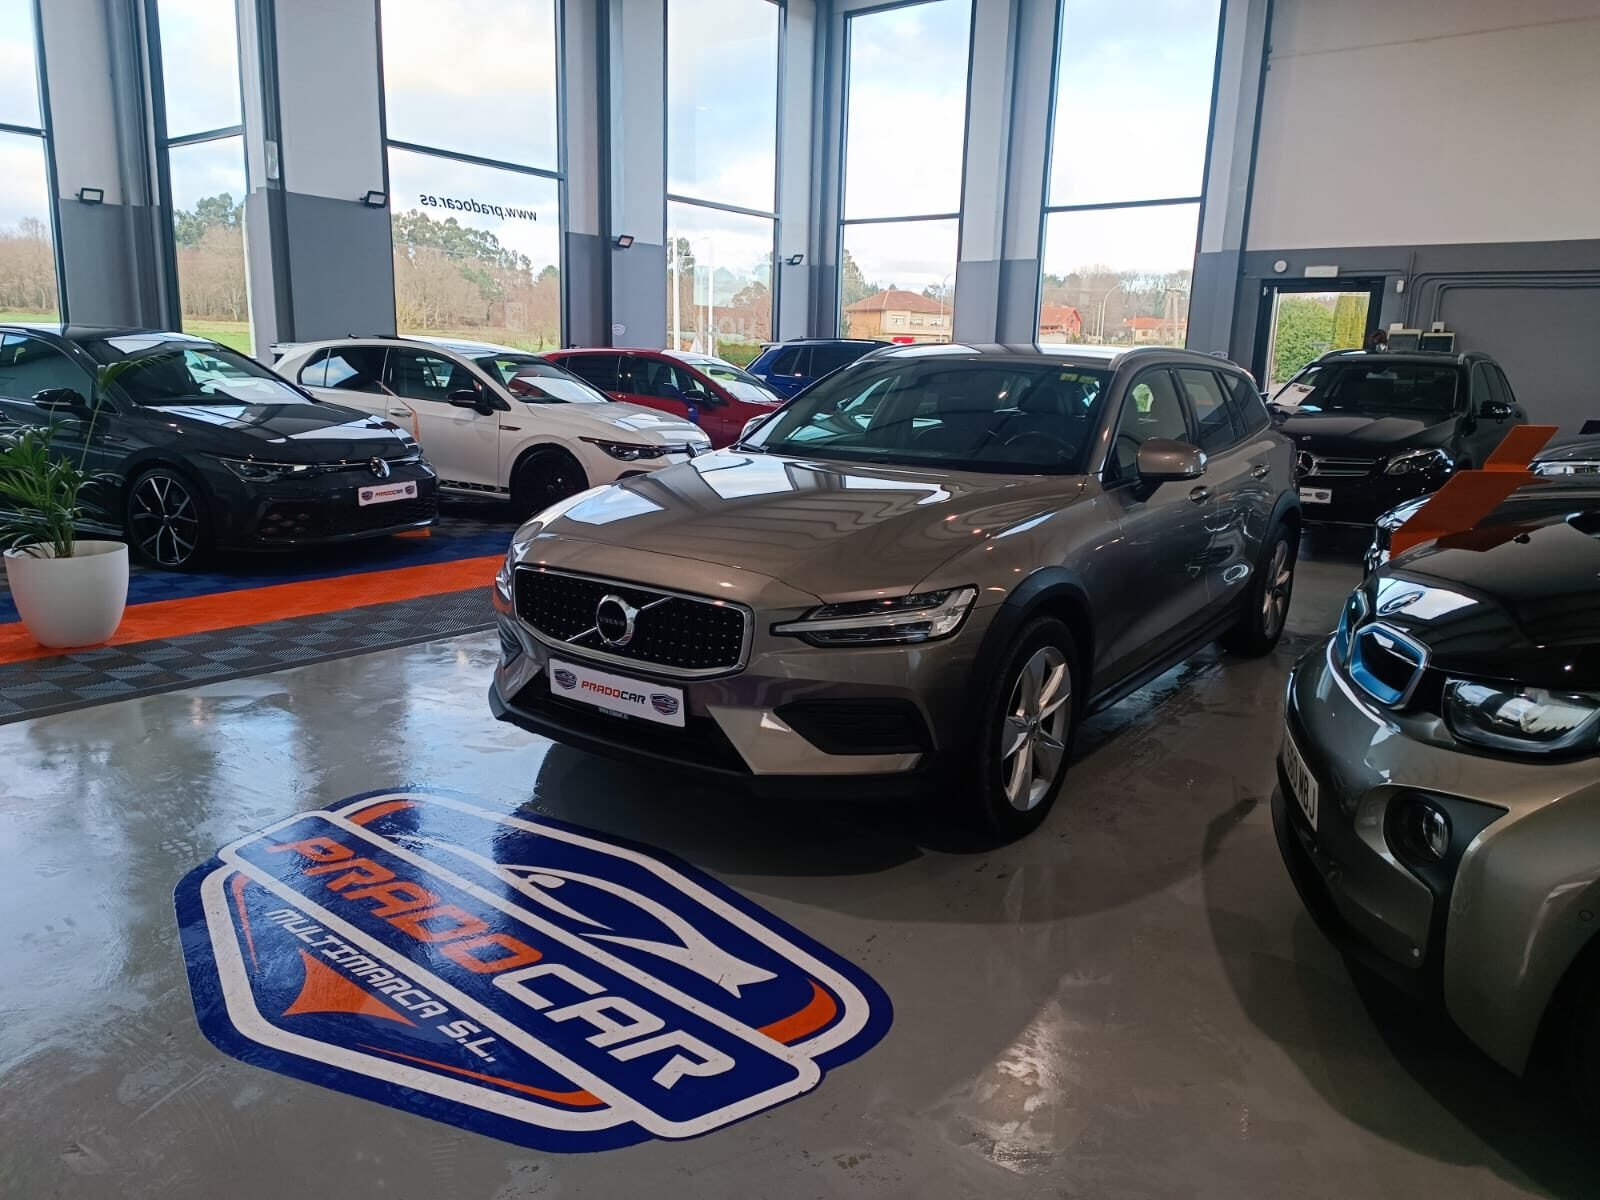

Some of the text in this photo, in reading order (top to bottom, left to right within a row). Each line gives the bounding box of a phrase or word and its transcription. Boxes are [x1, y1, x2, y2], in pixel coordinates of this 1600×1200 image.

[599, 616, 626, 626] VOLVO
[581, 680, 646, 704] PRADOCAR
[265, 836, 736, 1090] PRADOCAR
[265, 908, 497, 1063] MULTIMARCA S.L.
